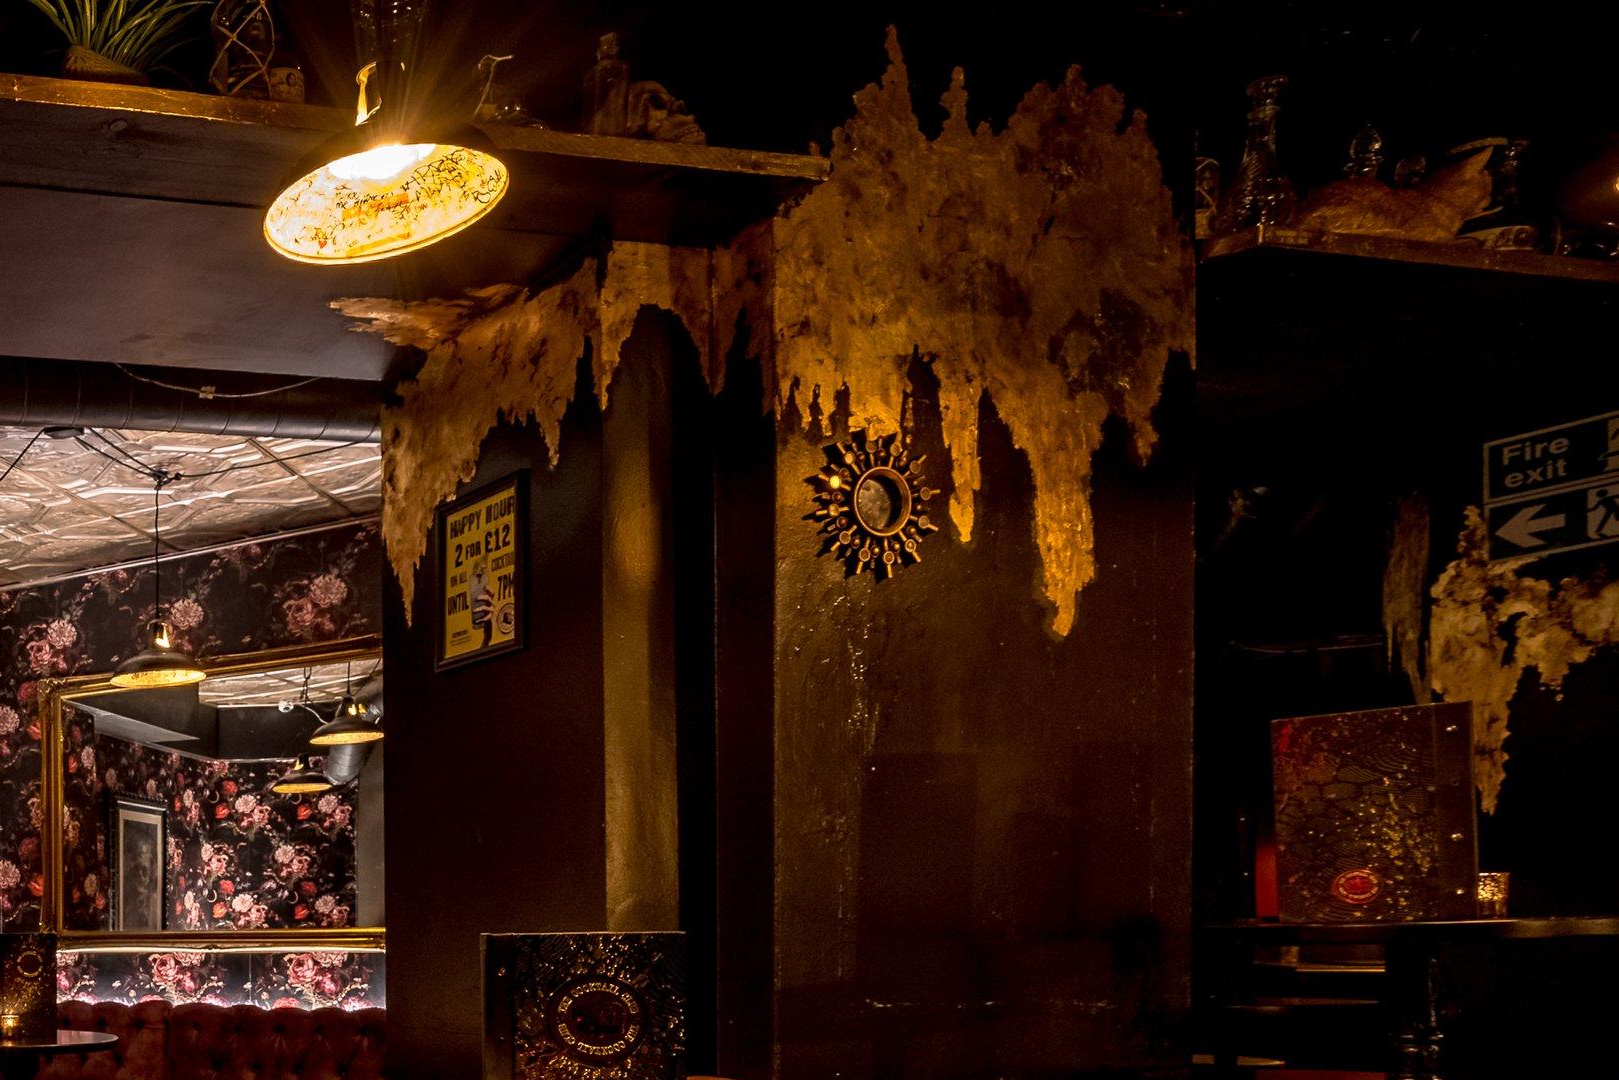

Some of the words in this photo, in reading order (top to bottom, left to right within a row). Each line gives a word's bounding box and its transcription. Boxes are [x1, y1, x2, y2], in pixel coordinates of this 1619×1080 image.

[1502, 437, 1570, 466] Fire
[1504, 458, 1567, 488] exit
[450, 509, 482, 539] HAPPY
[454, 543, 463, 568] 2
[465, 540, 481, 560] FOR
[485, 524, 511, 553] £12
[447, 590, 470, 616] UNTIL
